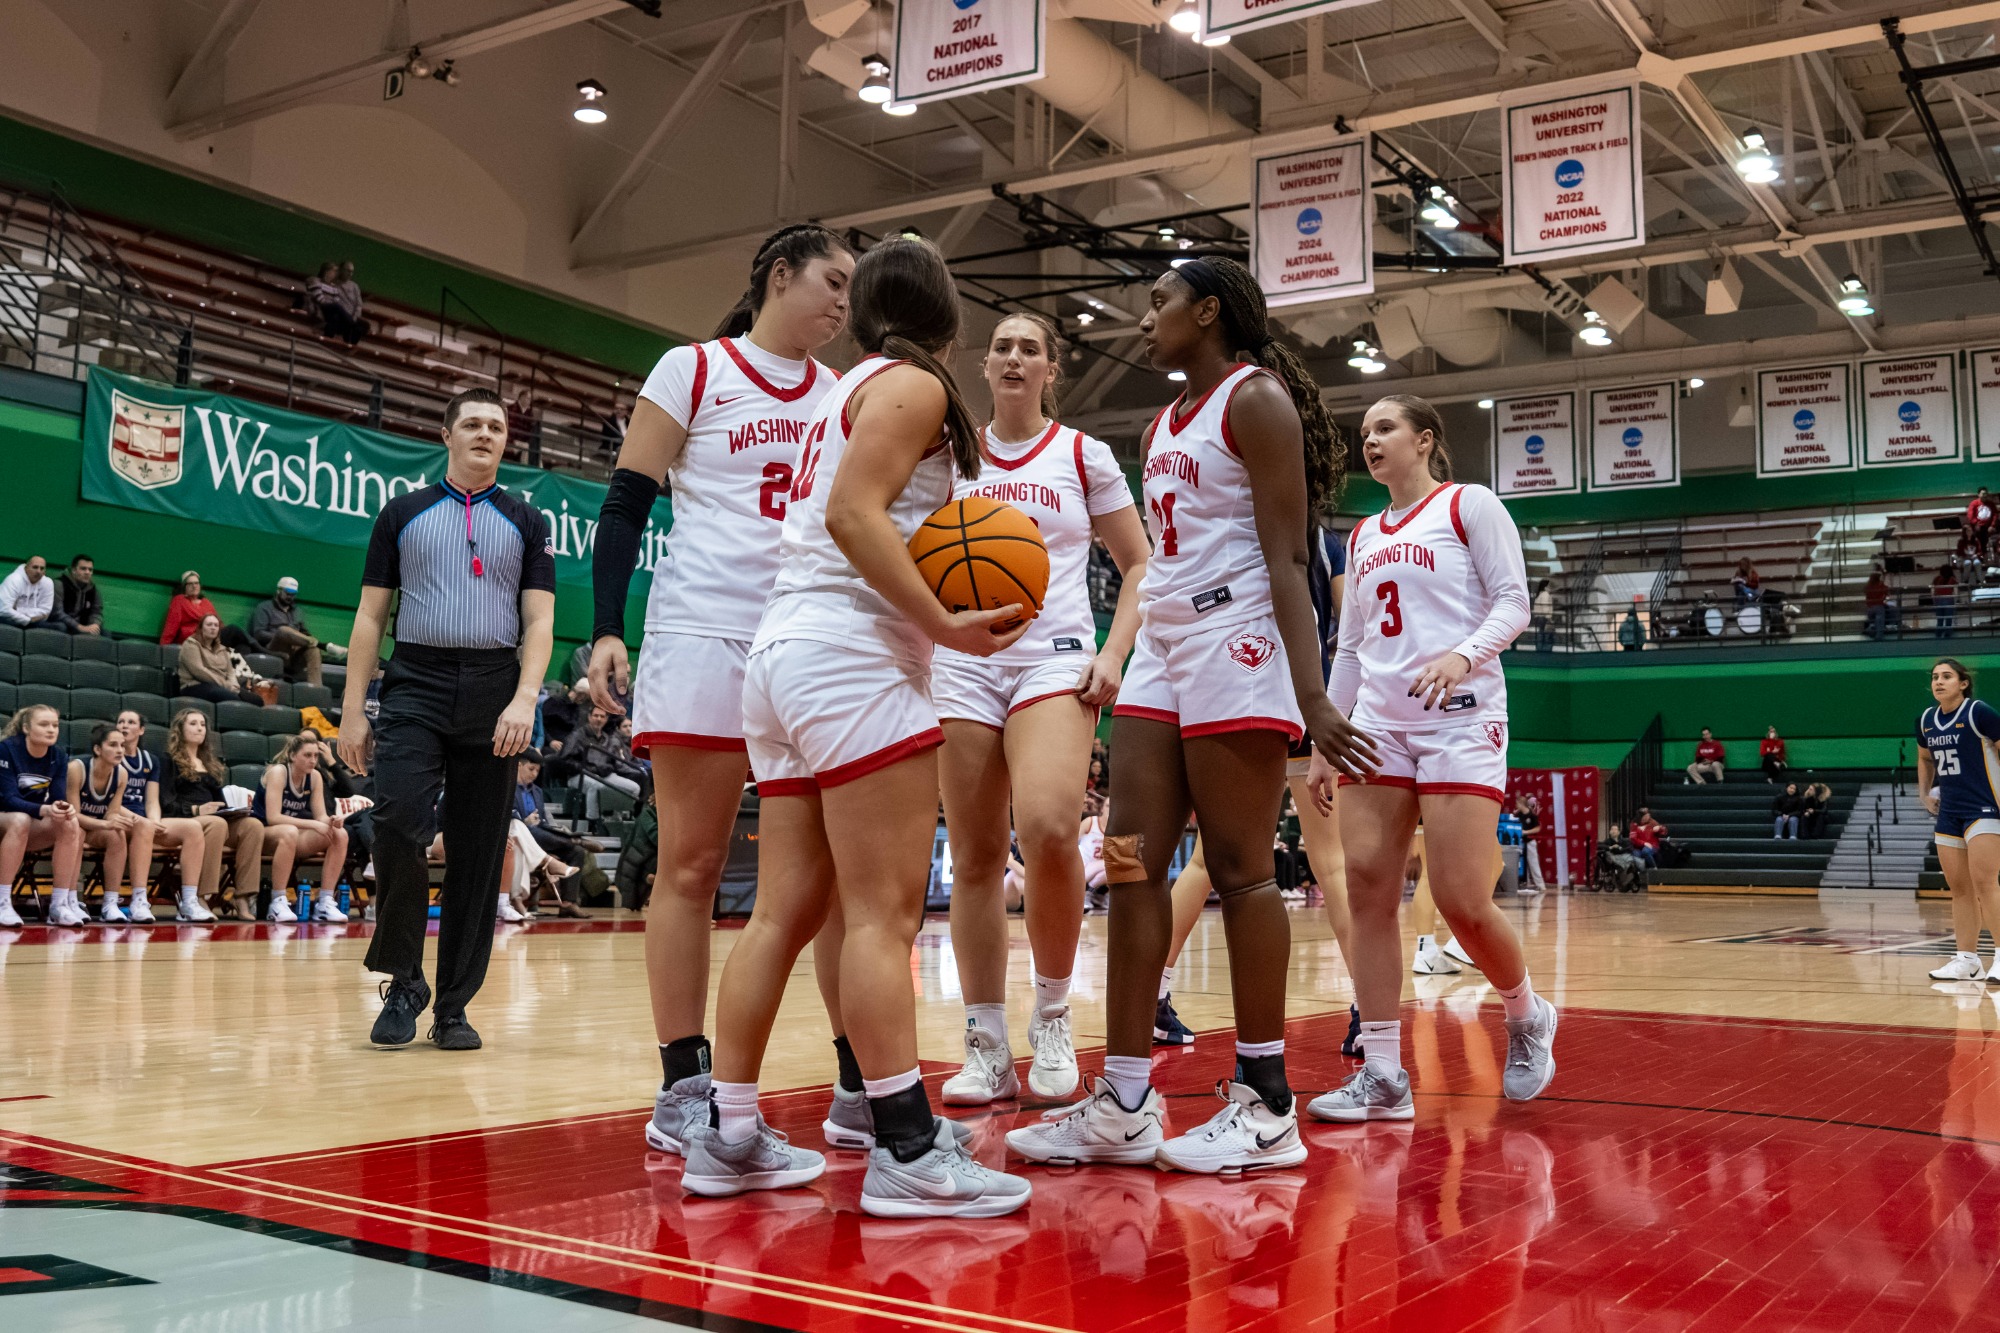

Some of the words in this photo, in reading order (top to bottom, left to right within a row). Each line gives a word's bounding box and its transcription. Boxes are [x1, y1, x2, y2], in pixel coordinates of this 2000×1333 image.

[952, 14, 982, 34] 2017
[934, 33, 998, 59] NATIONAL
[927, 54, 1003, 82] CHAMPIONS
[386, 72, 403, 99] D
[1531, 103, 1607, 126] WASHINGTON
[1535, 120, 1604, 141] UNIVERSITY
[1513, 152, 1537, 163] MEN'S
[1538, 147, 1568, 159] INDOOR
[1570, 142, 1597, 154] TRACK
[1598, 141, 1604, 150] &
[1606, 137, 1628, 149] FIELD
[1277, 156, 1343, 176] WASHINGTON
[1280, 172, 1340, 191] UNIVERSITY
[1558, 171, 1584, 183] NCAA
[1556, 191, 1584, 205] 2022
[1544, 205, 1601, 222] NATIONAL
[1539, 220, 1607, 241] CHAMPIONS
[1298, 238, 1322, 251] 2024
[1285, 251, 1335, 268] NATIONAL
[1280, 266, 1340, 284] CHAMPIONS
[1879, 360, 1938, 374] WASHINGTON
[1775, 370, 1832, 383] WASHINGTON
[1881, 373, 1935, 386] UNIVERSITY
[1606, 389, 1659, 402] WASHINGTON
[1778, 383, 1829, 395] UNIVERSITY
[1869, 389, 1902, 399] WOMEN'S
[1903, 385, 1948, 396] VOLLEYBALL
[1509, 398, 1559, 411] WASHINGTON
[1609, 401, 1656, 413] UNIVERSITY
[1766, 398, 1797, 408] WOMEN'S
[1798, 395, 1841, 405] VOLLEYBALL
[1512, 410, 1557, 422] UNIVERSITY
[1899, 422, 1921, 432] 1993
[728, 418, 809, 455] WASHIN
[1795, 432, 1815, 441] 1992
[1888, 434, 1933, 446] NATIONAL
[1784, 443, 1826, 454] NATIONAL
[1884, 446, 1937, 458] CHAMPIONS
[1613, 459, 1652, 470] NATIONAL
[1780, 455, 1831, 467] CHAMPIONS
[1142, 450, 1199, 488] SHINGTON
[1516, 468, 1553, 477] NATIONAL
[1610, 470, 1656, 481] CHAMPIONS
[1512, 479, 1557, 488] CHAMPIONS
[969, 482, 1060, 513] ASHINGTON
[1356, 542, 1434, 590] ASHINGTON
[1376, 580, 1403, 638] 3
[1927, 734, 1960, 747] EMORY
[1933, 749, 1961, 776] 25
